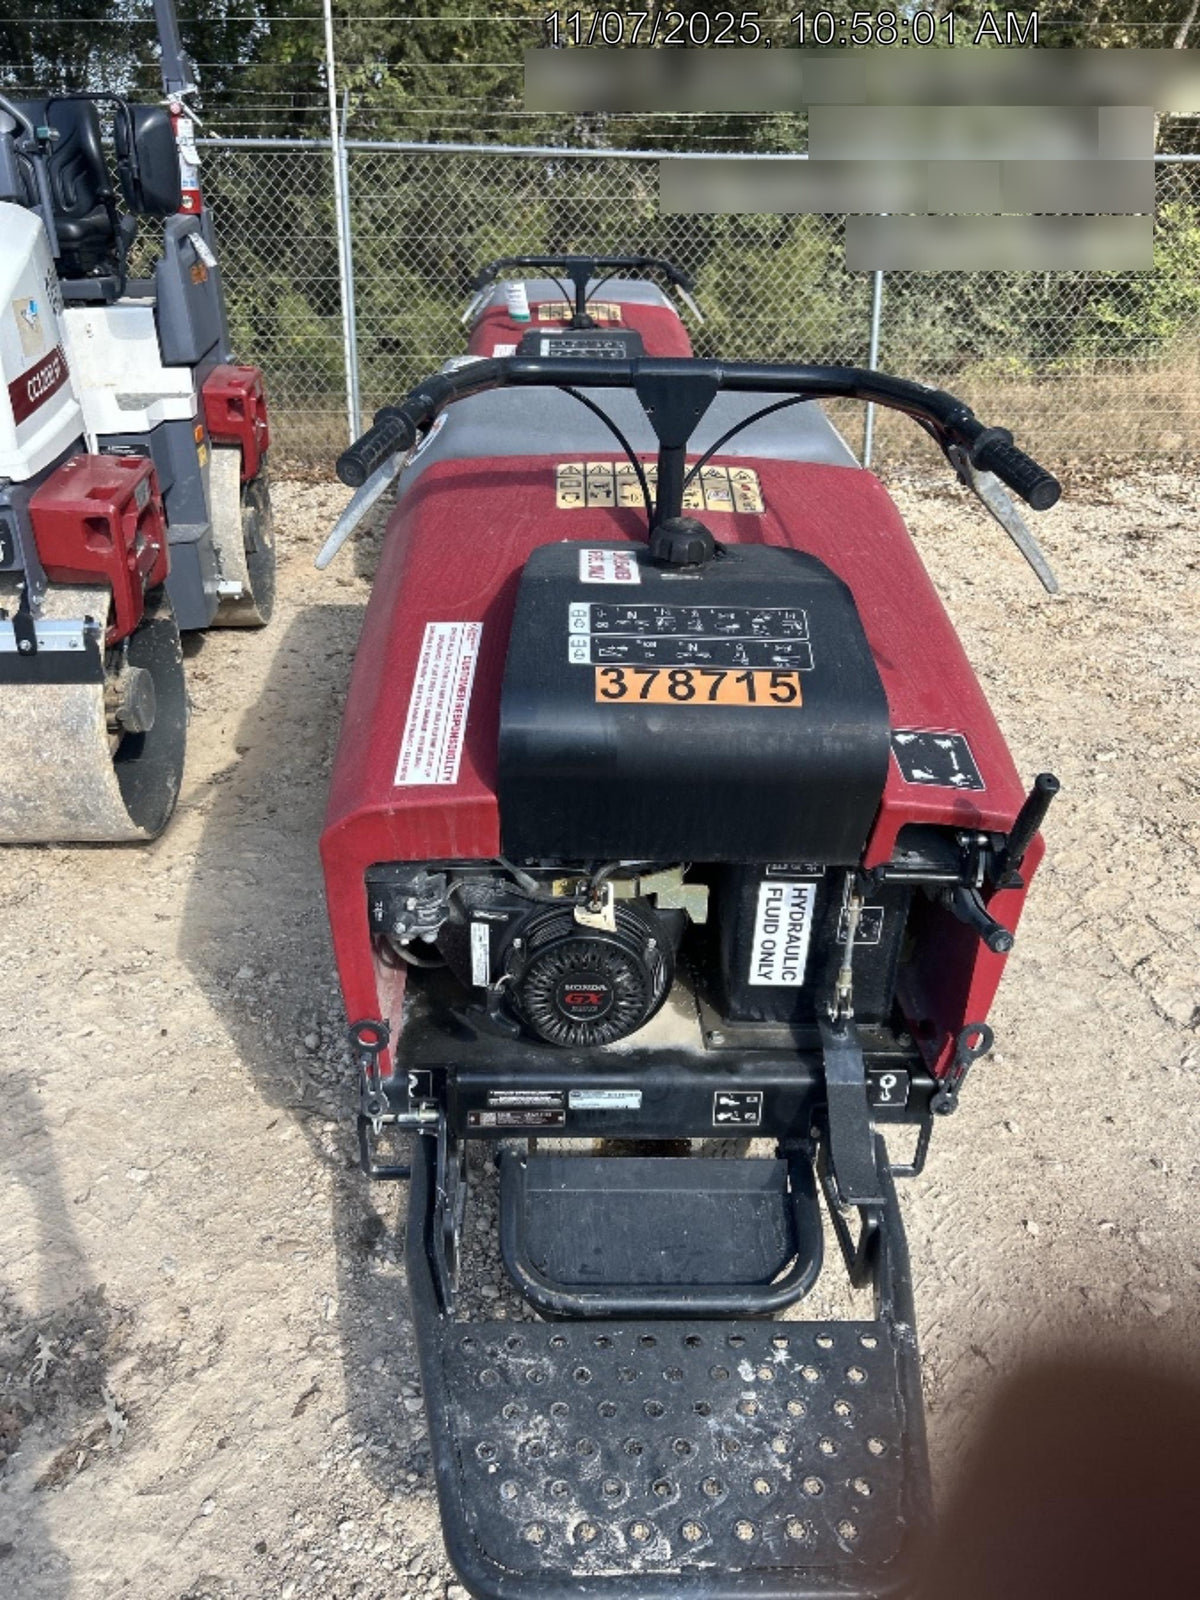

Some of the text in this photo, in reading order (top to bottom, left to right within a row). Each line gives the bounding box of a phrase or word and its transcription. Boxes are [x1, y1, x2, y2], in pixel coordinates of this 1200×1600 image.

[600, 666, 798, 704] 378715
[757, 887, 783, 981] FLUID ONLY
[781, 887, 808, 982] HYDRAULIC
[564, 992, 604, 1005] GX
